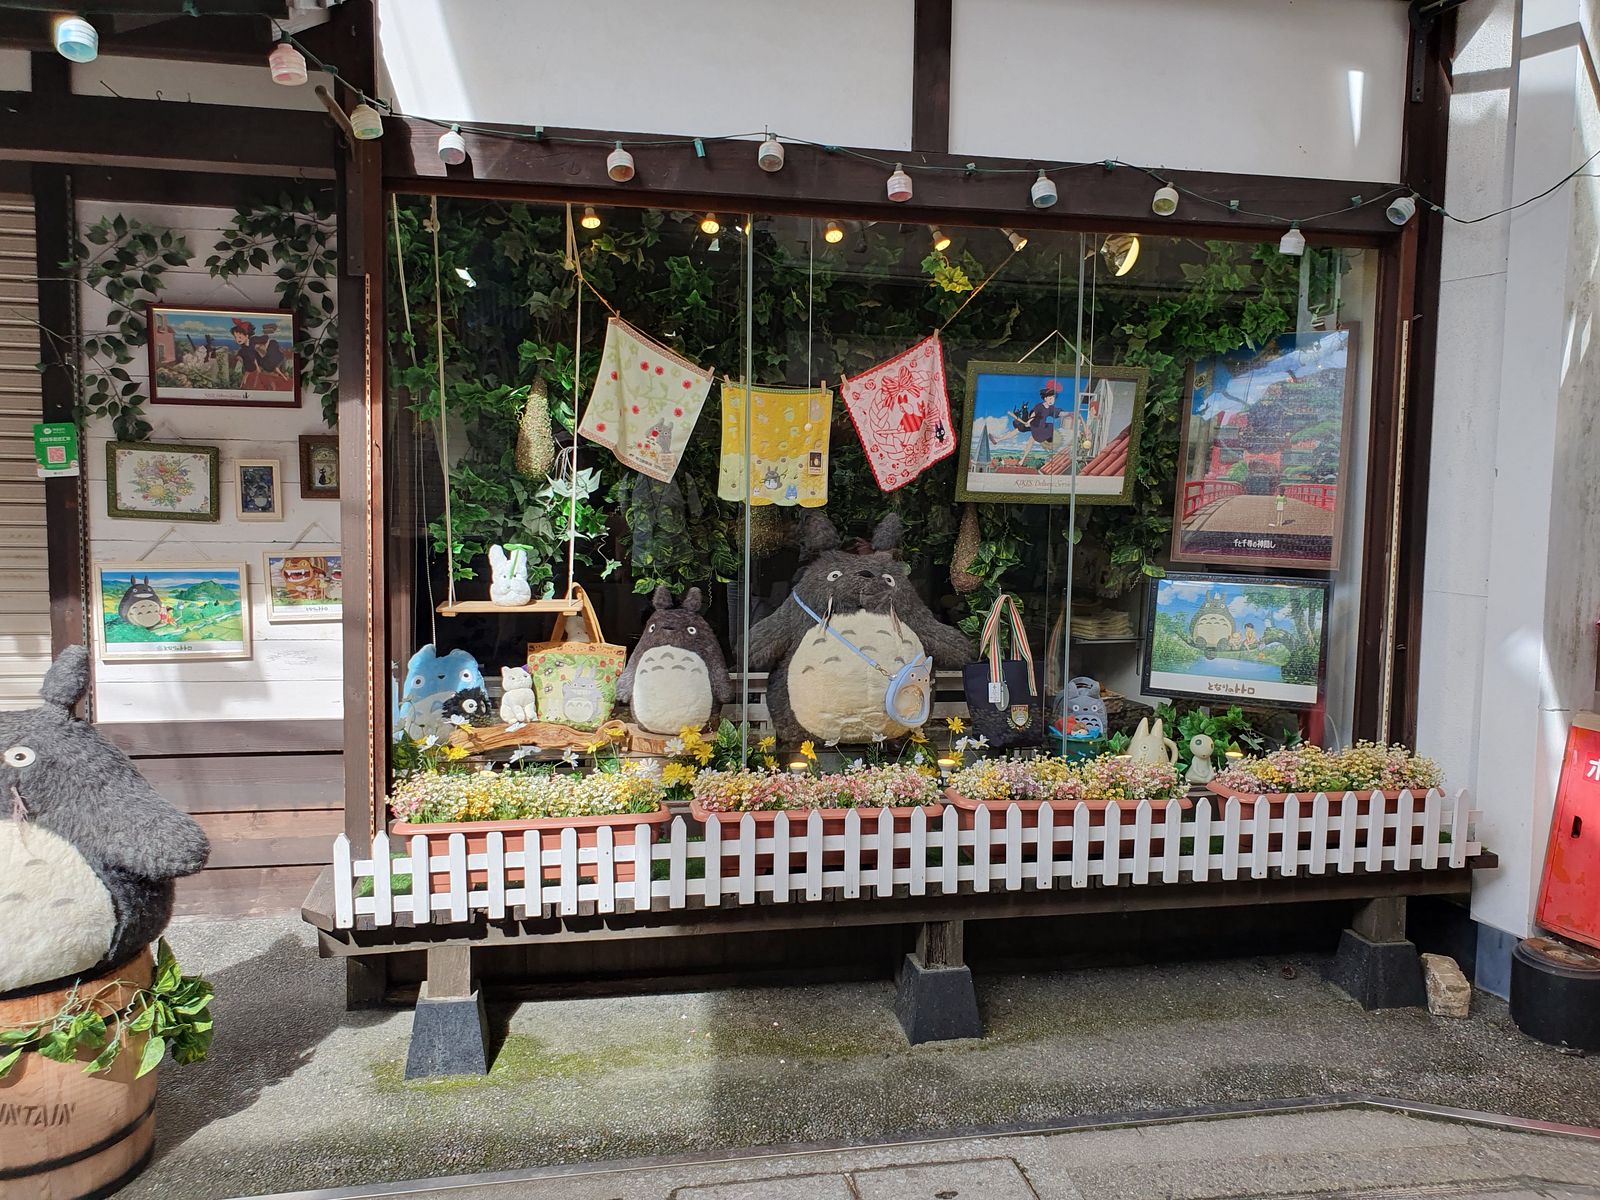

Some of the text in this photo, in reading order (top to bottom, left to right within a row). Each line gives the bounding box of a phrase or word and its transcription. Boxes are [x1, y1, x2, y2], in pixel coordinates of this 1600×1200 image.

[1233, 538, 1276, 549] 千と千尋の神隠し
[1208, 682, 1255, 694] となりのトトロ
